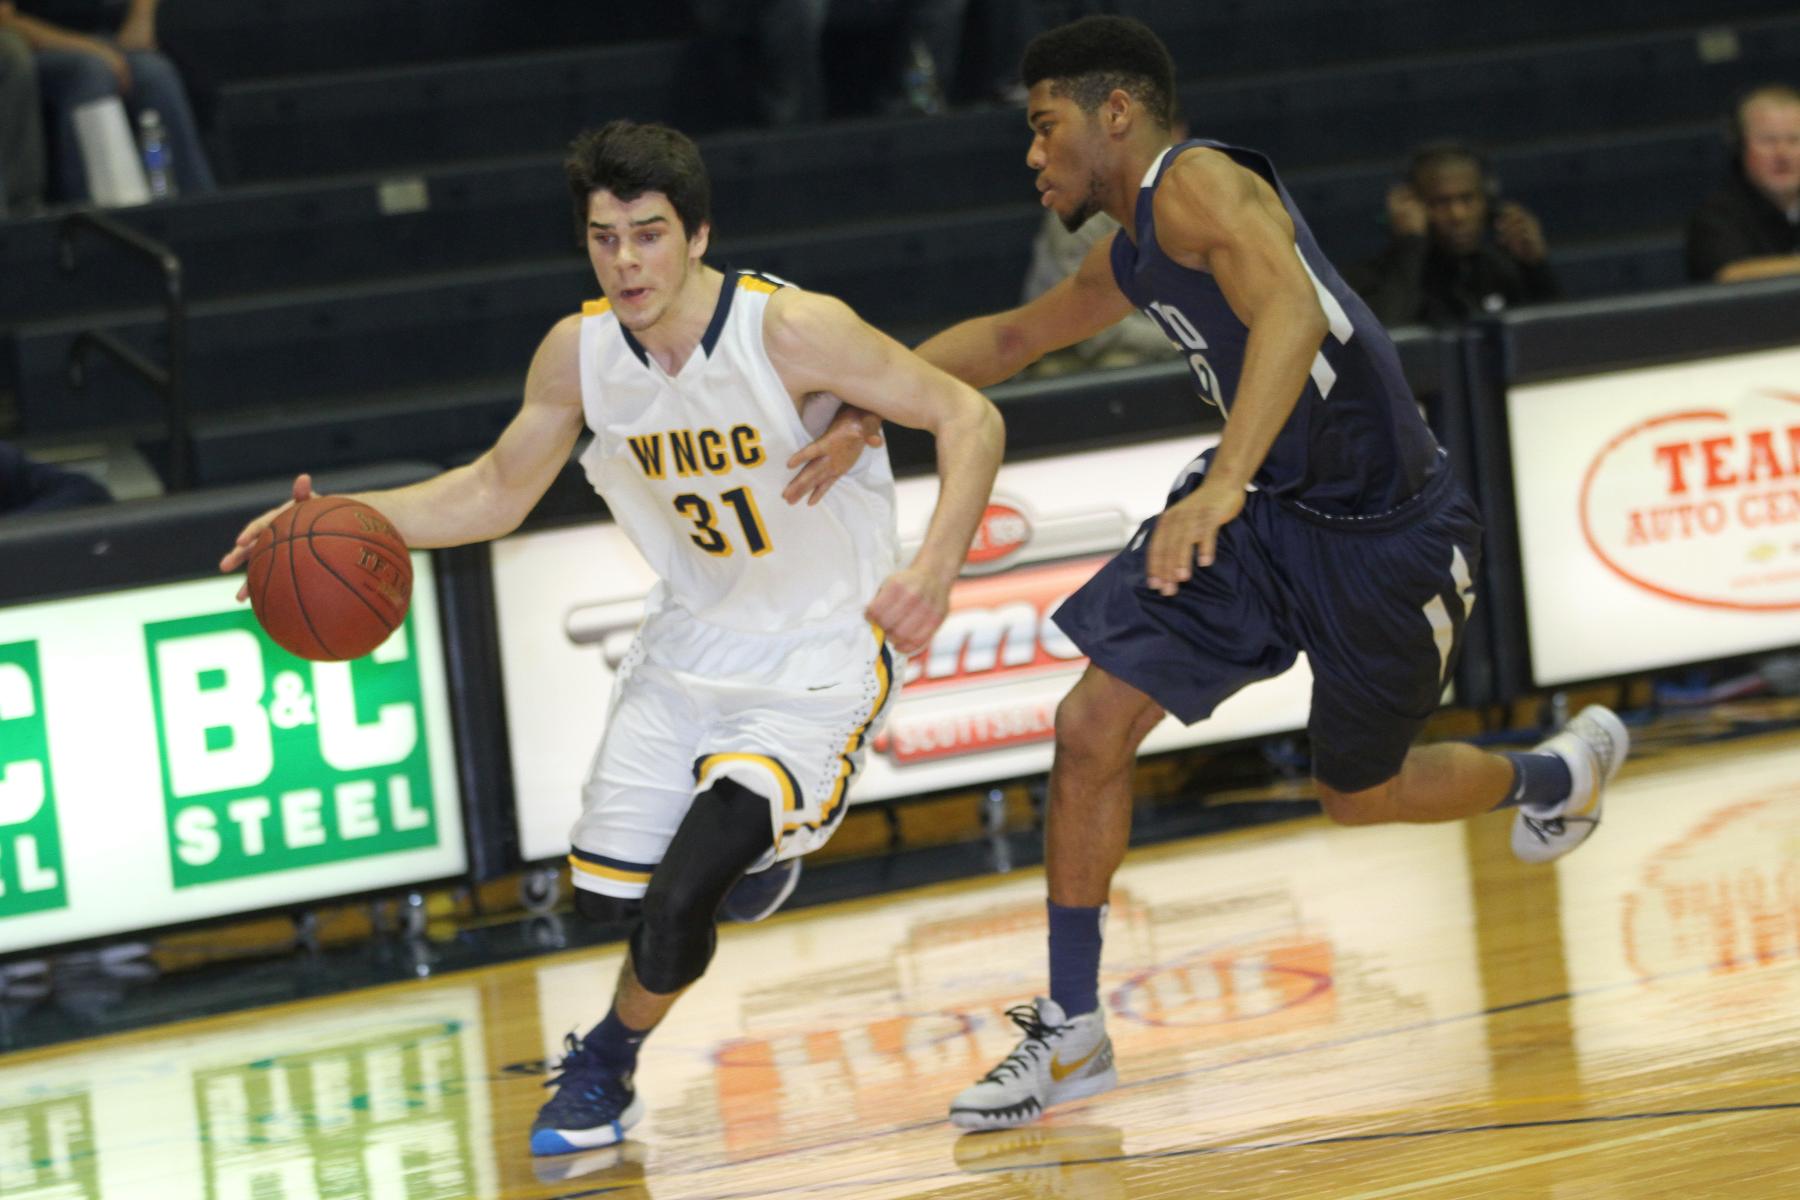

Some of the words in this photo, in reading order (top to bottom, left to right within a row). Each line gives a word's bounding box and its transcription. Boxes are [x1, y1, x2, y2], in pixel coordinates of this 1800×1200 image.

[626, 423, 767, 480] WNCC
[672, 485, 774, 557] 31
[1625, 499, 1727, 546] AUTO
[174, 776, 429, 866] STEEL
